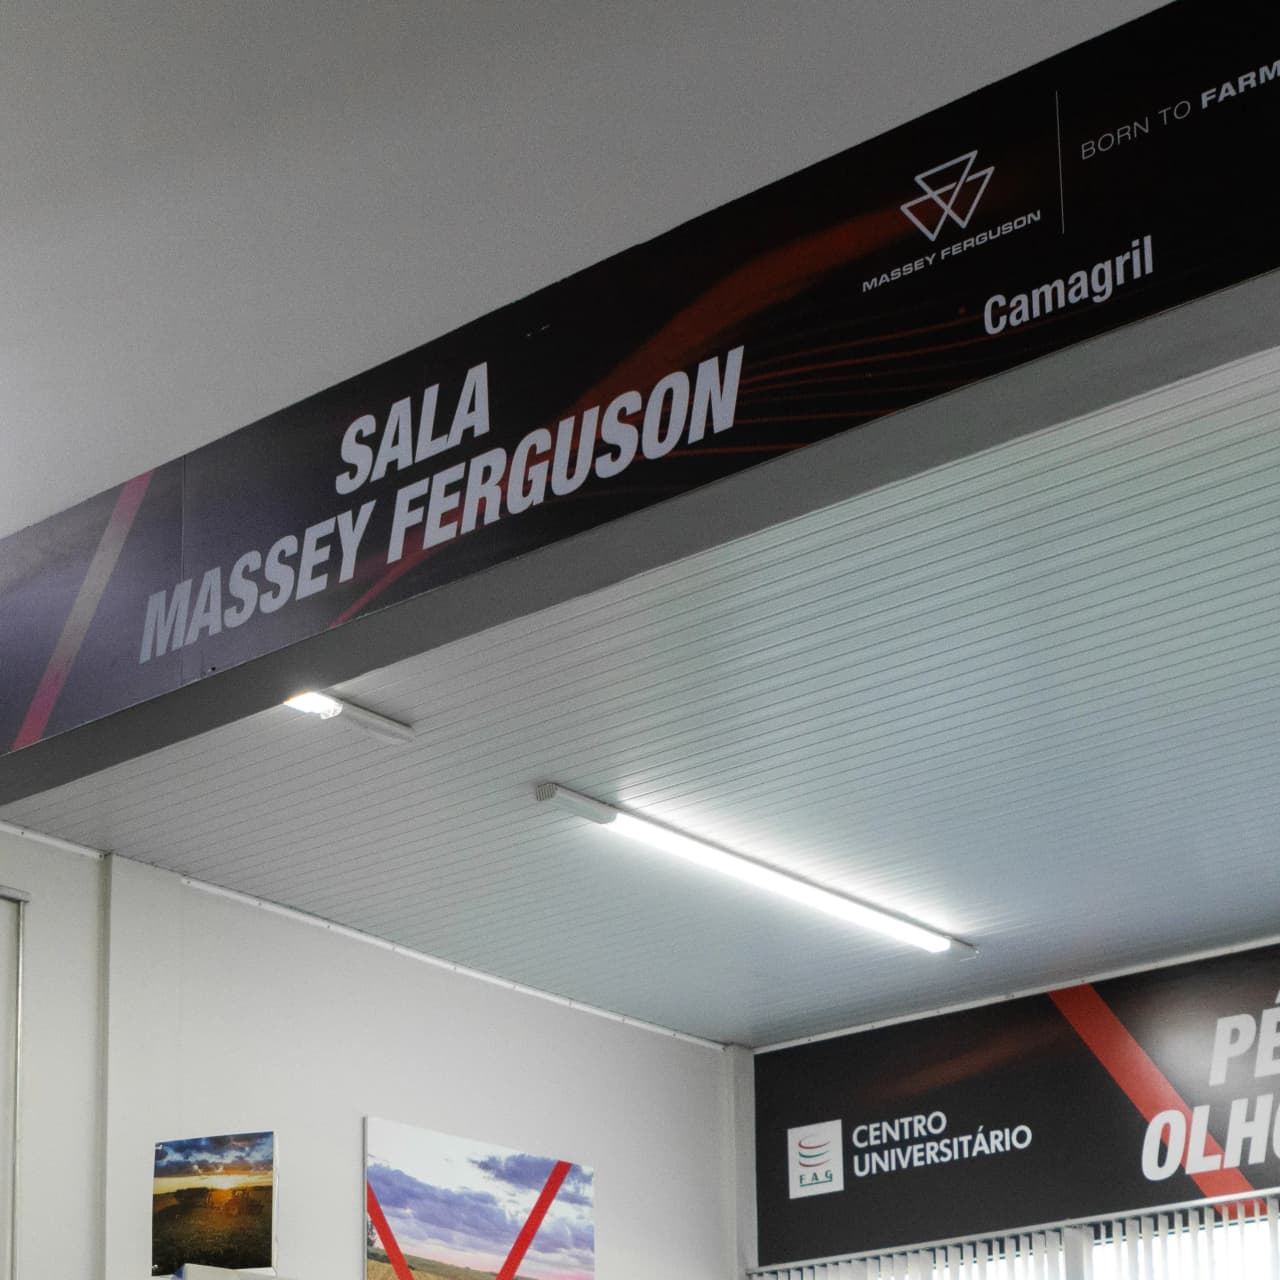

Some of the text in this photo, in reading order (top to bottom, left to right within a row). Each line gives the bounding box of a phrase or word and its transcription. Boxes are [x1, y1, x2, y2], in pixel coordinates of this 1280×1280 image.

[1081, 116, 1149, 160] BORN
[1158, 100, 1191, 126] TO
[862, 209, 1041, 293] MASSEY FERGUSON
[983, 234, 1154, 335] Camagril
[335, 361, 490, 496] SALA
[139, 345, 744, 664] MASSEY FERGUSON
[852, 1111, 947, 1148] CENTRO
[853, 1125, 1033, 1177] UNIVERSITÁRIO
